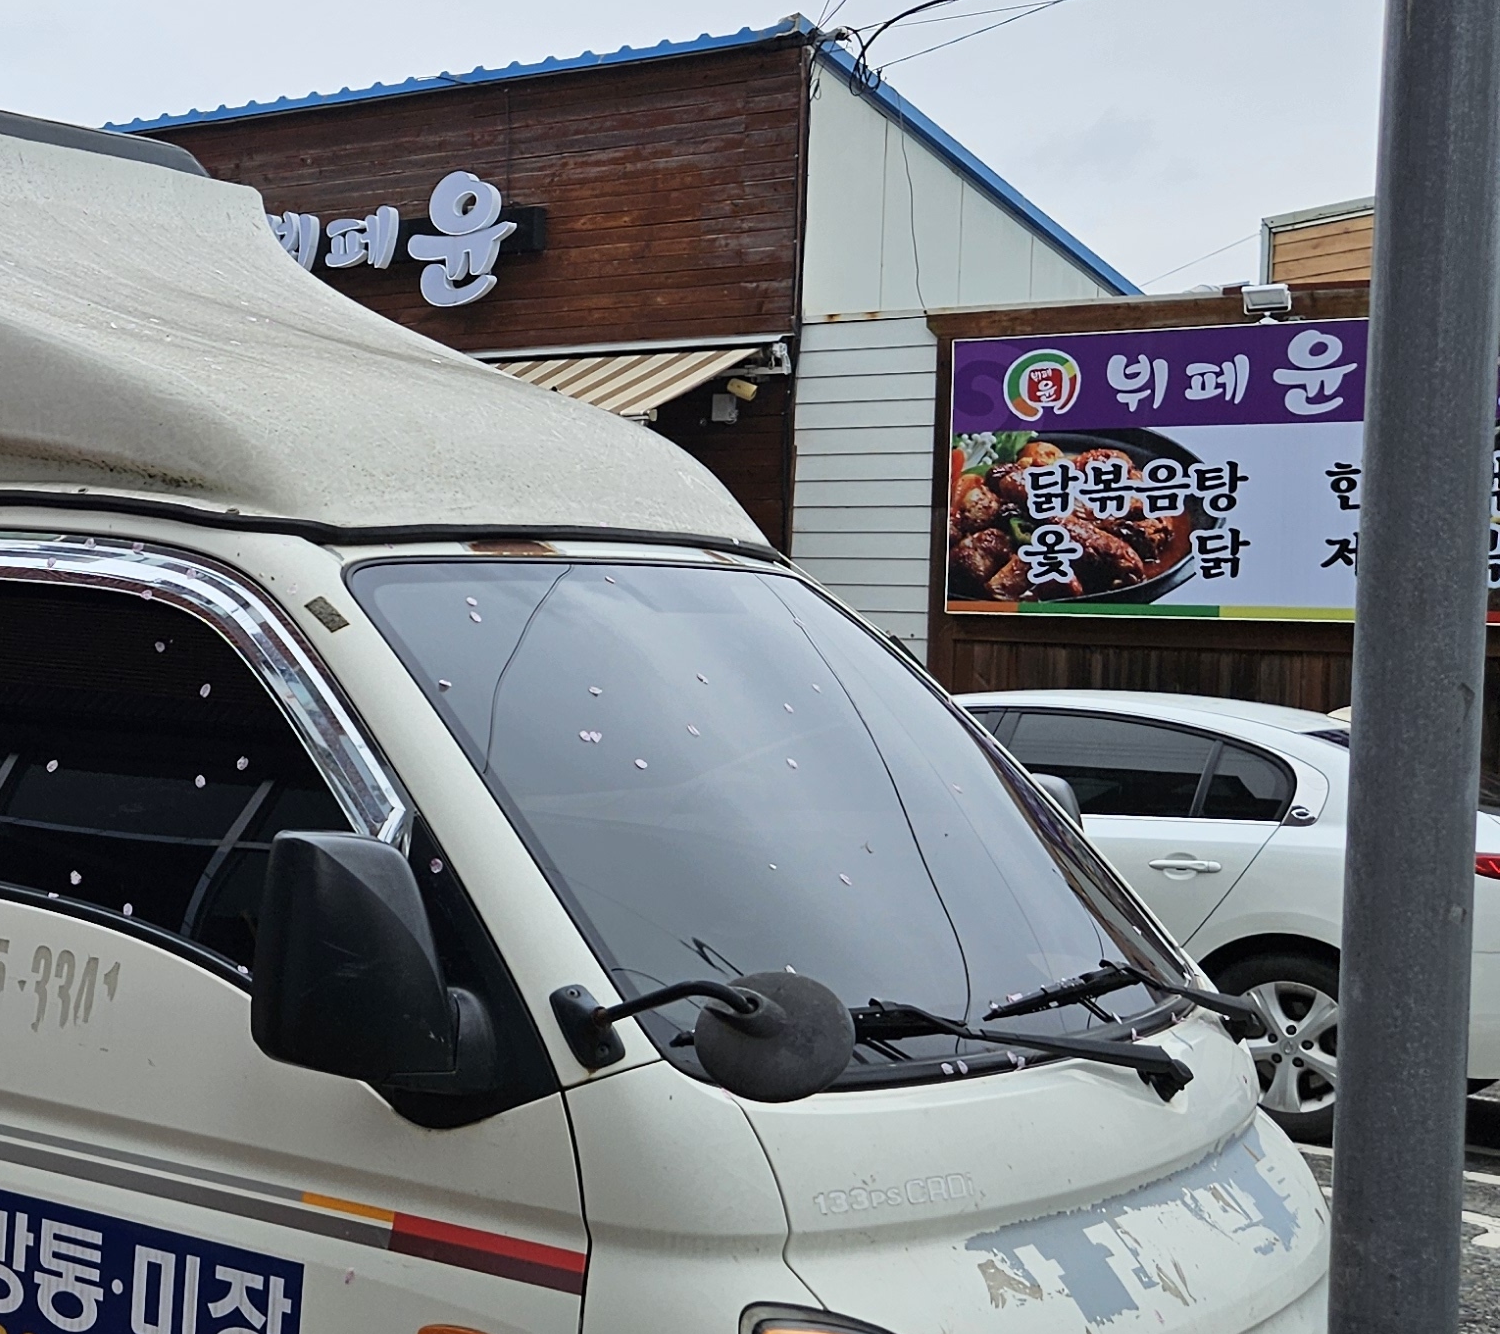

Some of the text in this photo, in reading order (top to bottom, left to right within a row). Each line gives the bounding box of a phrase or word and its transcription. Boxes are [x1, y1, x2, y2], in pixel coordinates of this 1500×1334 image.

[408, 170, 517, 307] 윤
[1036, 380, 1057, 403] 윤
[1106, 329, 1358, 416] 뷔페 윤
[1028, 460, 1250, 514] 닭볶음탕
[813, 1171, 974, 1216] 133PS CRDi
